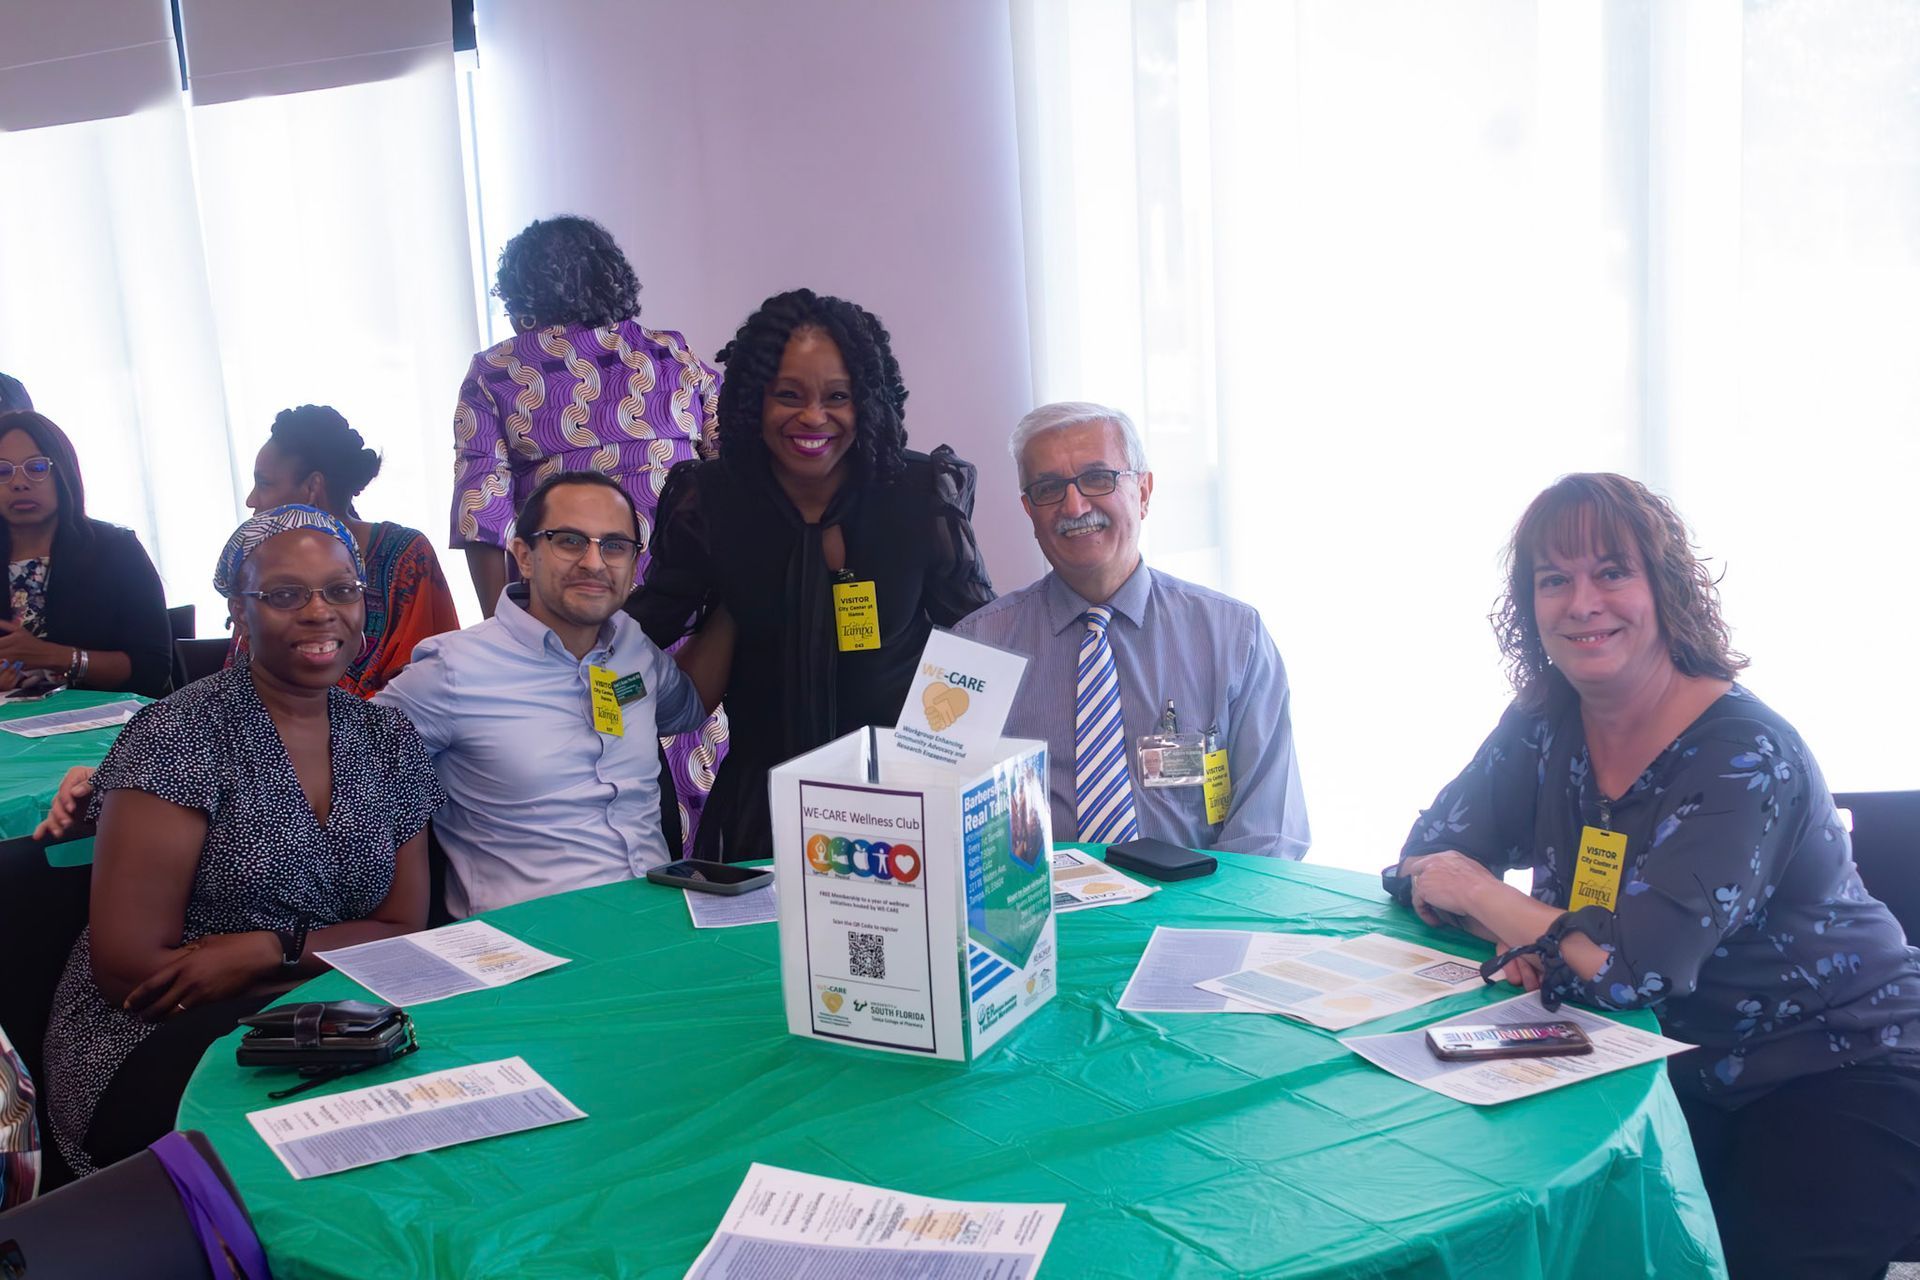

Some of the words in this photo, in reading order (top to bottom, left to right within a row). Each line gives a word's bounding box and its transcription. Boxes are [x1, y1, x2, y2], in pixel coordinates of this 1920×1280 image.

[842, 625, 874, 638] Tampa
[595, 680, 612, 688] VISITO
[922, 663, 986, 692] WE-CARE
[894, 732, 927, 747] Community
[927, 743, 954, 755] Advocacy
[903, 726, 935, 740] Workgroup
[935, 736, 964, 750] Enhancing
[897, 742, 922, 754] Research
[923, 748, 957, 764] Engagement
[804, 807, 846, 822] WE-CARE
[850, 813, 893, 827] Wellness
[896, 817, 919, 830] Club
[965, 805, 988, 834] Real
[1581, 856, 1592, 864] City
[1593, 859, 1611, 868] Center
[1587, 846, 1617, 860] VISITOR
[832, 892, 860, 901] Membership
[1578, 881, 1611, 904] Tampa
[871, 1006, 894, 1016] SOUTH
[895, 1010, 925, 1021] FLORIDA
